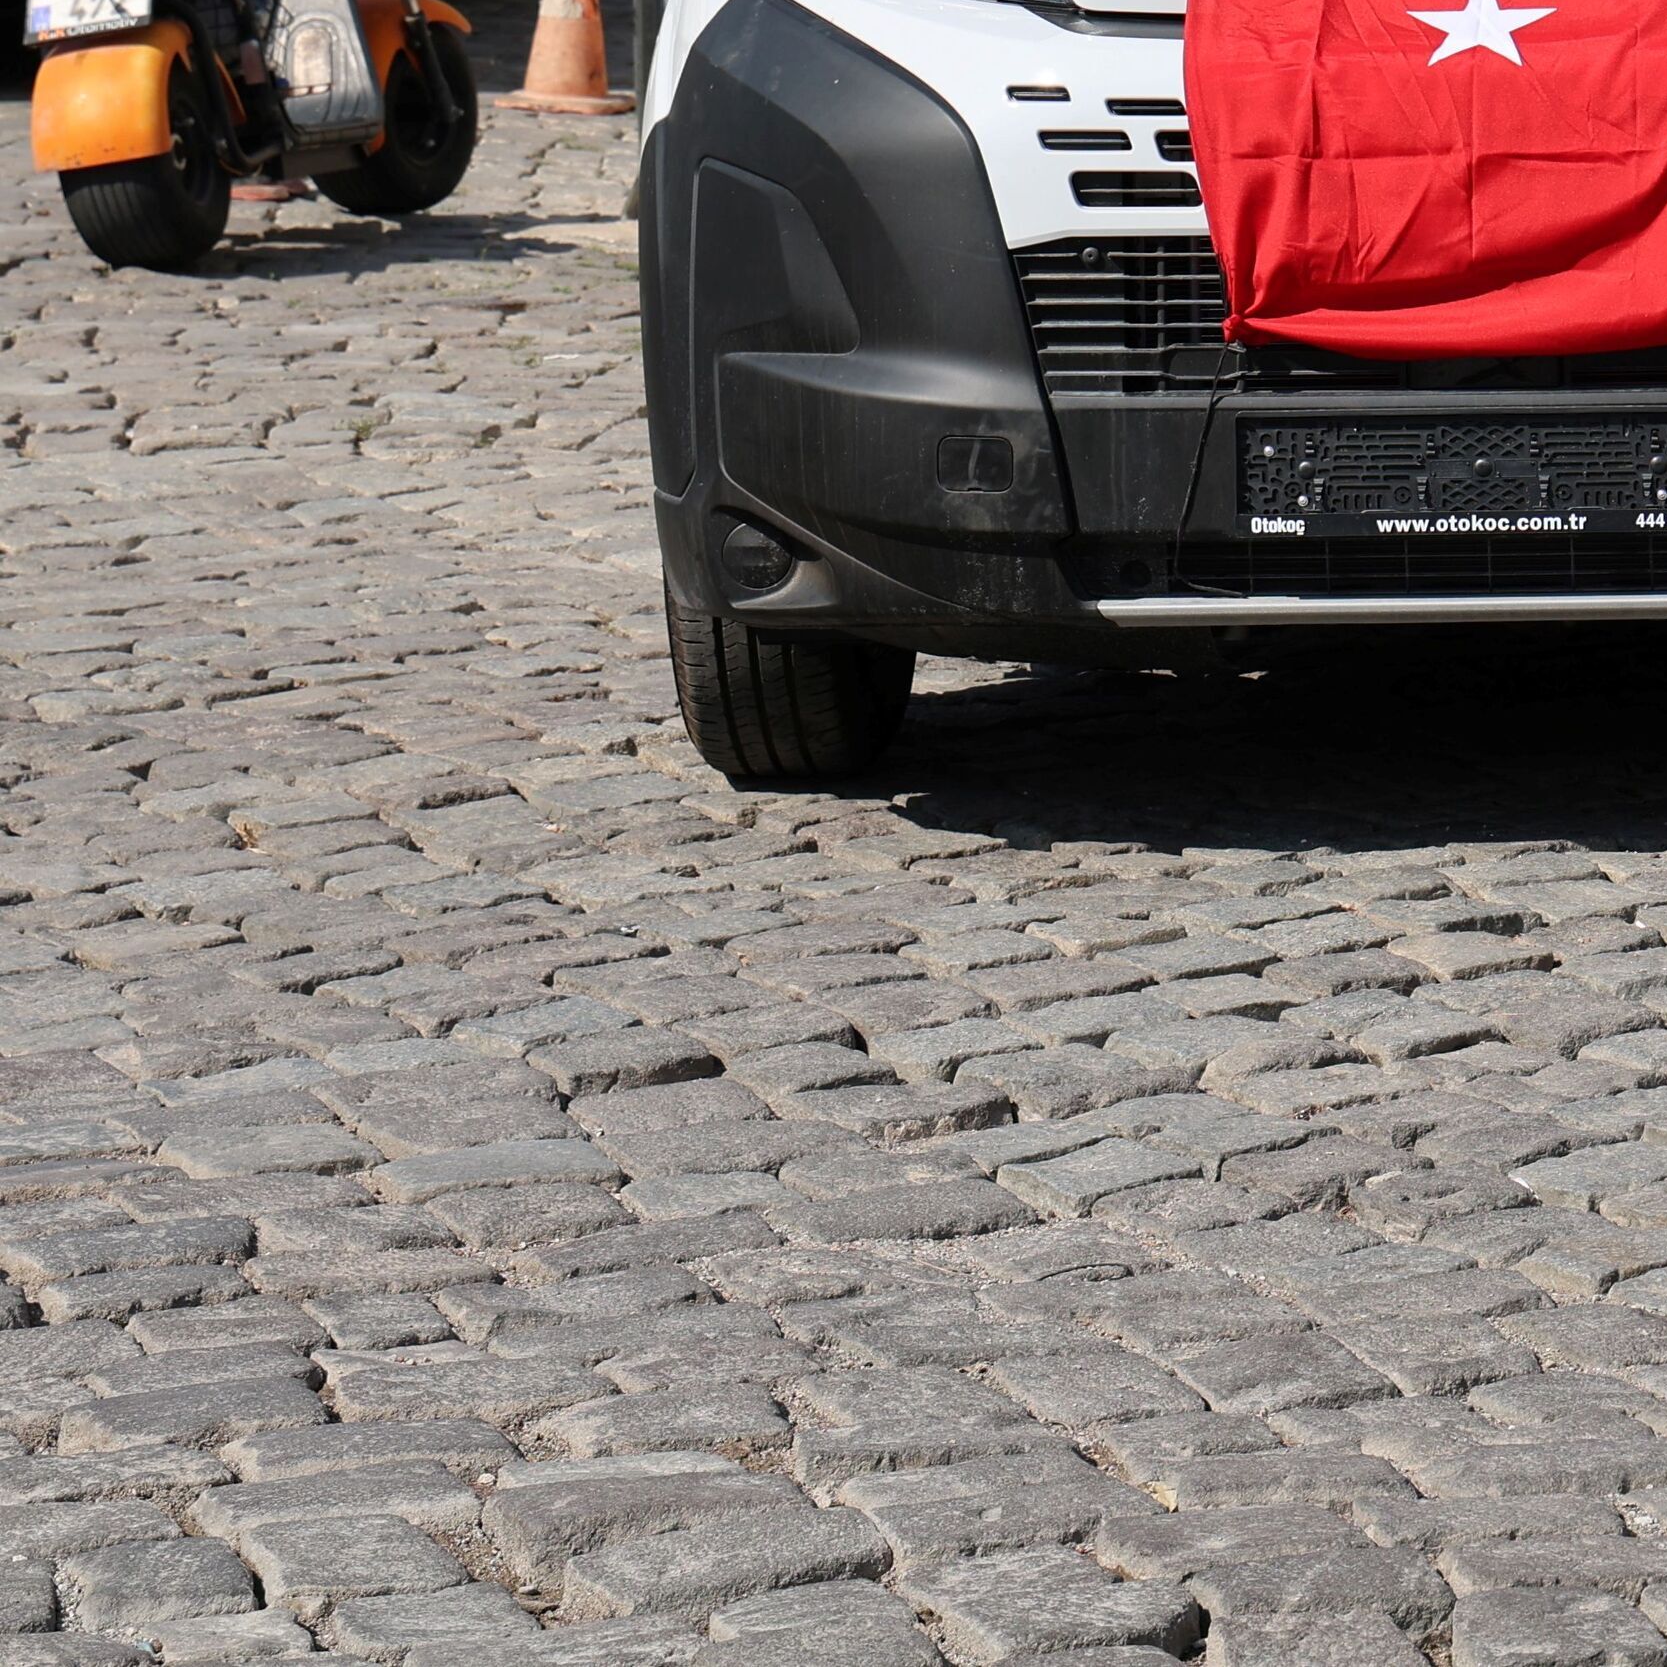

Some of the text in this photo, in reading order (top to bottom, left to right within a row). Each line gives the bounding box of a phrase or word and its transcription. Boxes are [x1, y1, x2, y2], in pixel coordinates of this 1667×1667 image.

[1250, 516, 1305, 536] Otokoç
[1376, 514, 1588, 533] www.otokoc.com.tr
[1635, 512, 1667, 529] 444
